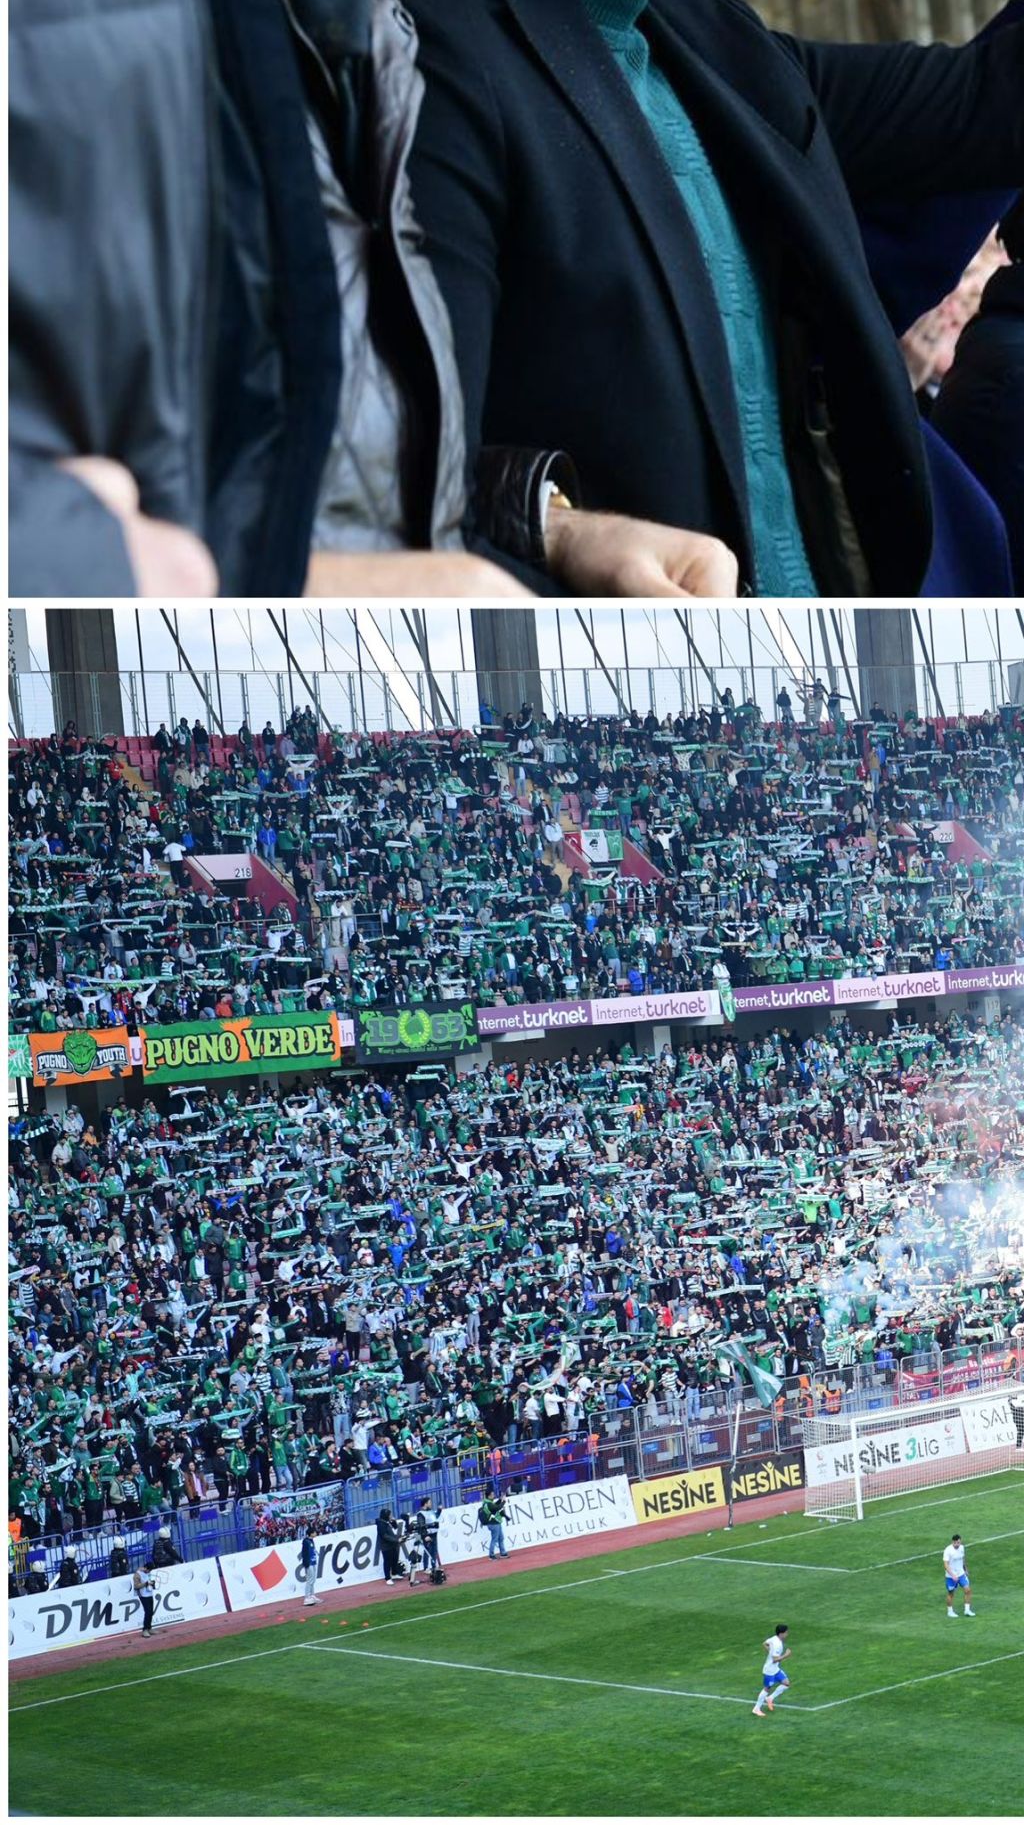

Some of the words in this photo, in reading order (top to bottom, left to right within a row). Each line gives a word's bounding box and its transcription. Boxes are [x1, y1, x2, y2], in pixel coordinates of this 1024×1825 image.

[771, 987, 831, 1008] turknet
[883, 975, 942, 997] turknet
[477, 1015, 522, 1030] nternet,
[522, 1005, 588, 1027] turknet
[645, 996, 707, 1018] turknet
[368, 1016, 400, 1047] 19
[97, 1048, 126, 1065] YOUTH
[146, 1031, 239, 1070] PUGNO
[242, 1023, 335, 1058] VERDE
[38, 1054, 68, 1070] PUGNO
[541, 1485, 616, 1519] ERDEN
[481, 1516, 608, 1552] KYUMCULUK
